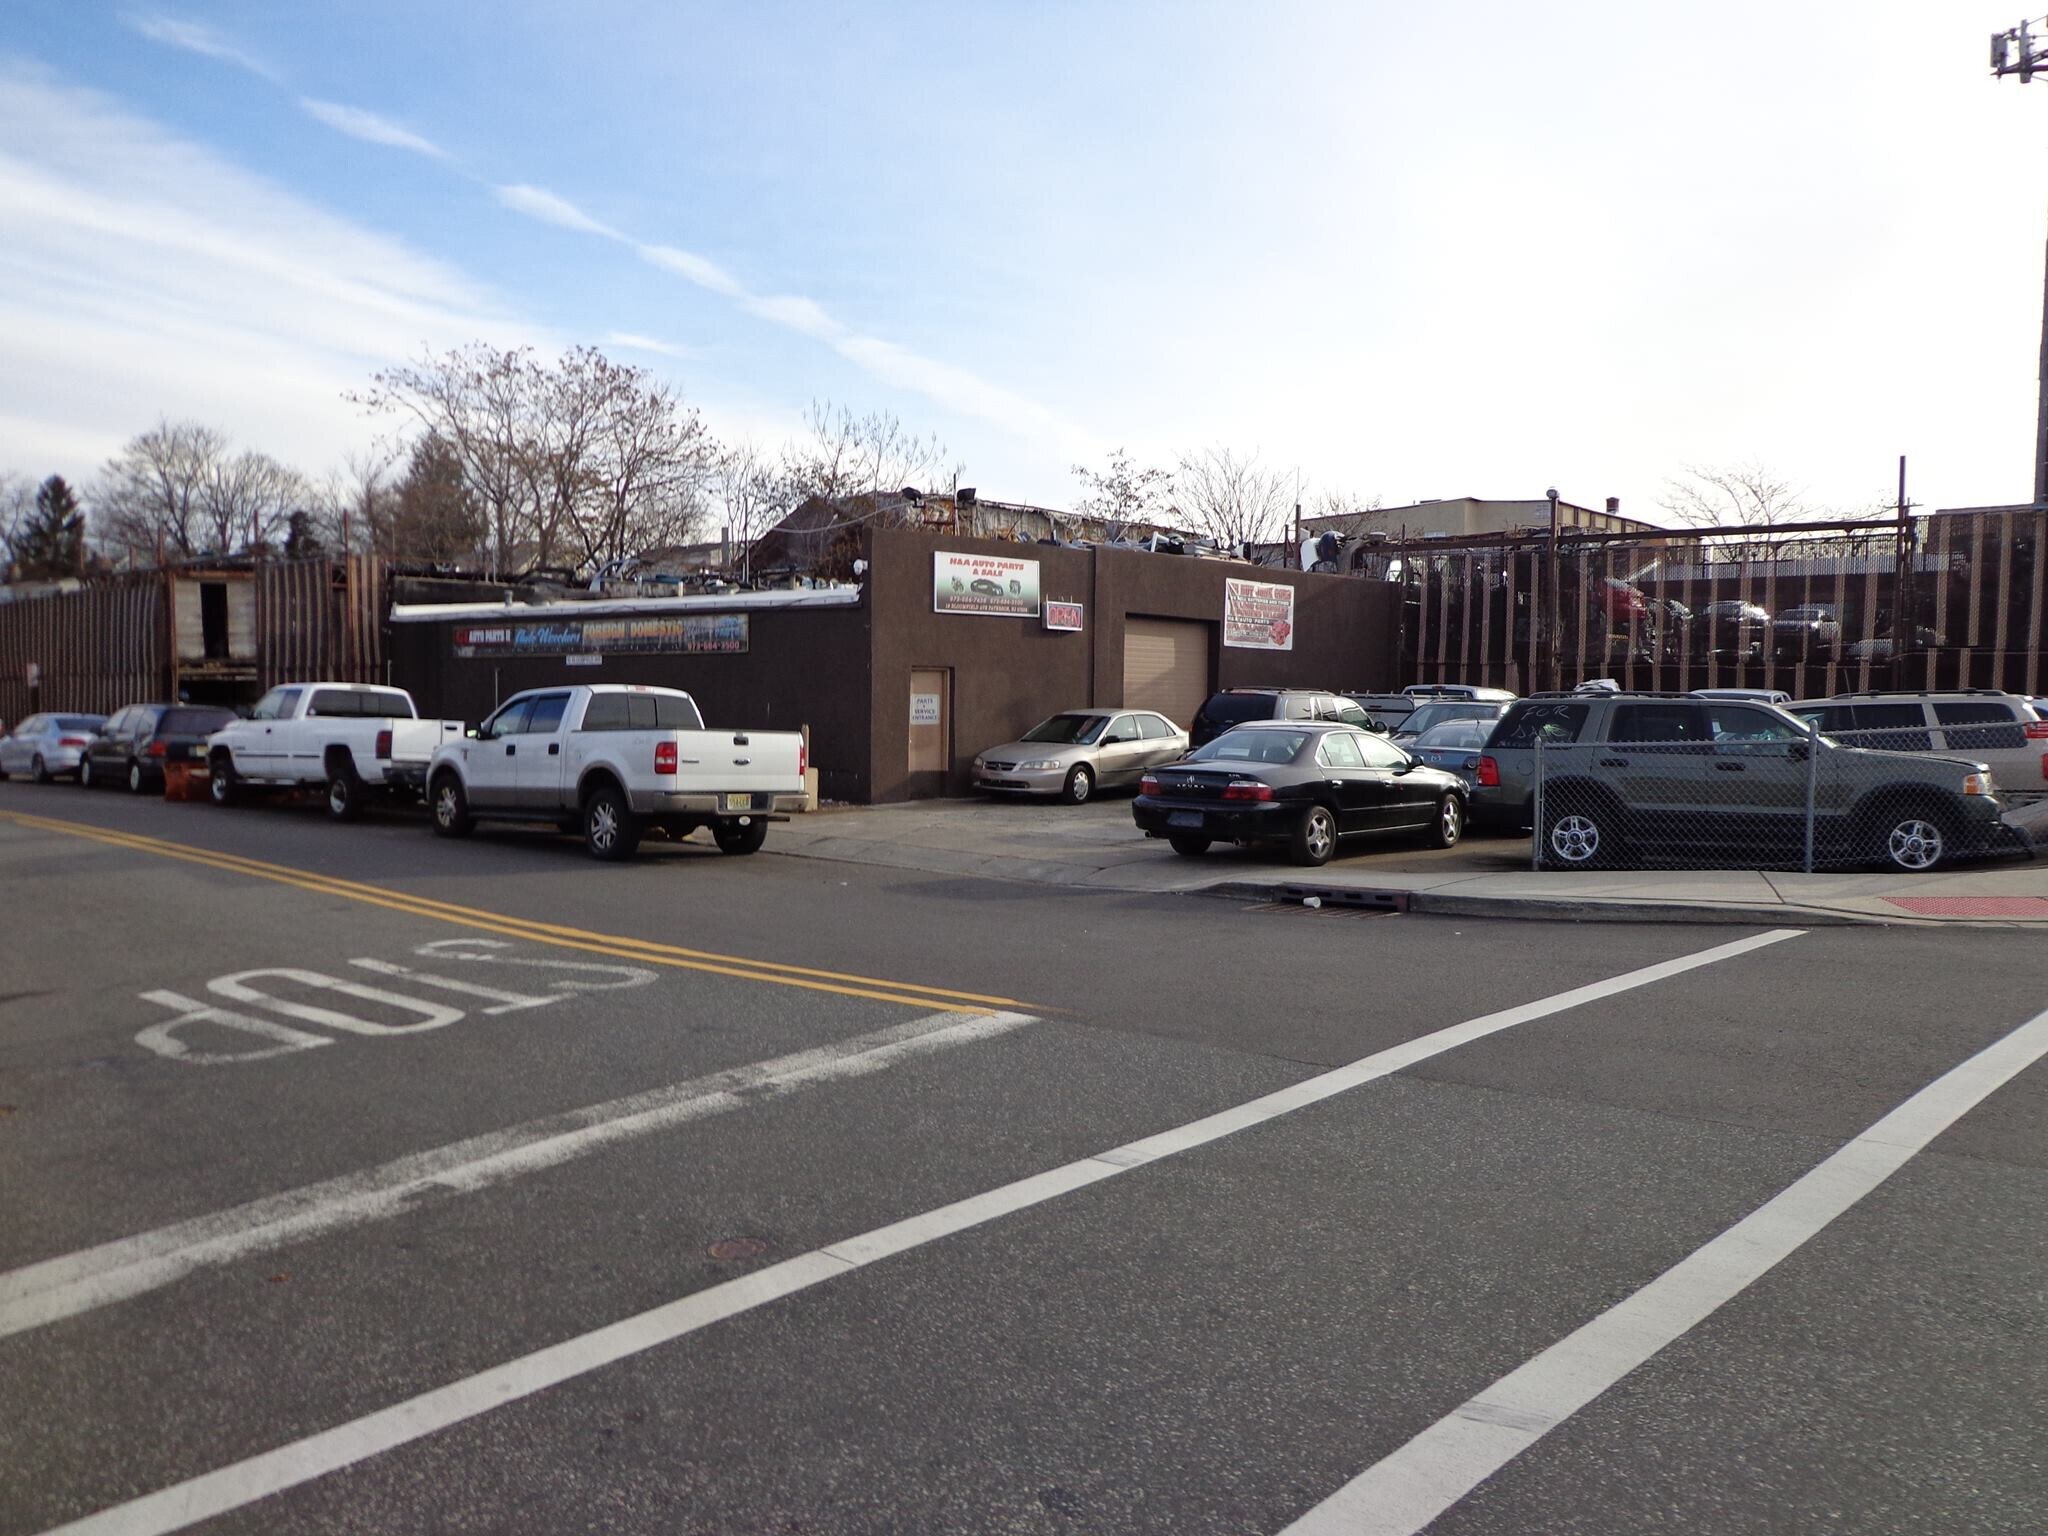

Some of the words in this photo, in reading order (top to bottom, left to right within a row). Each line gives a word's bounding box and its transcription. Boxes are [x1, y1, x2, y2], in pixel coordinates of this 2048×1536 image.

[971, 559, 996, 568] AUTO
[997, 562, 1025, 570] PARTS
[981, 569, 1003, 577] SALE
[1049, 607, 1081, 627] OPEN
[469, 629, 485, 643] AUTO
[485, 629, 505, 643] PARTS
[583, 621, 626, 640] FOREIGN
[630, 620, 683, 637] DOMESTIC
[1520, 705, 1570, 721] FOR
[134, 937, 659, 1066] STOP
